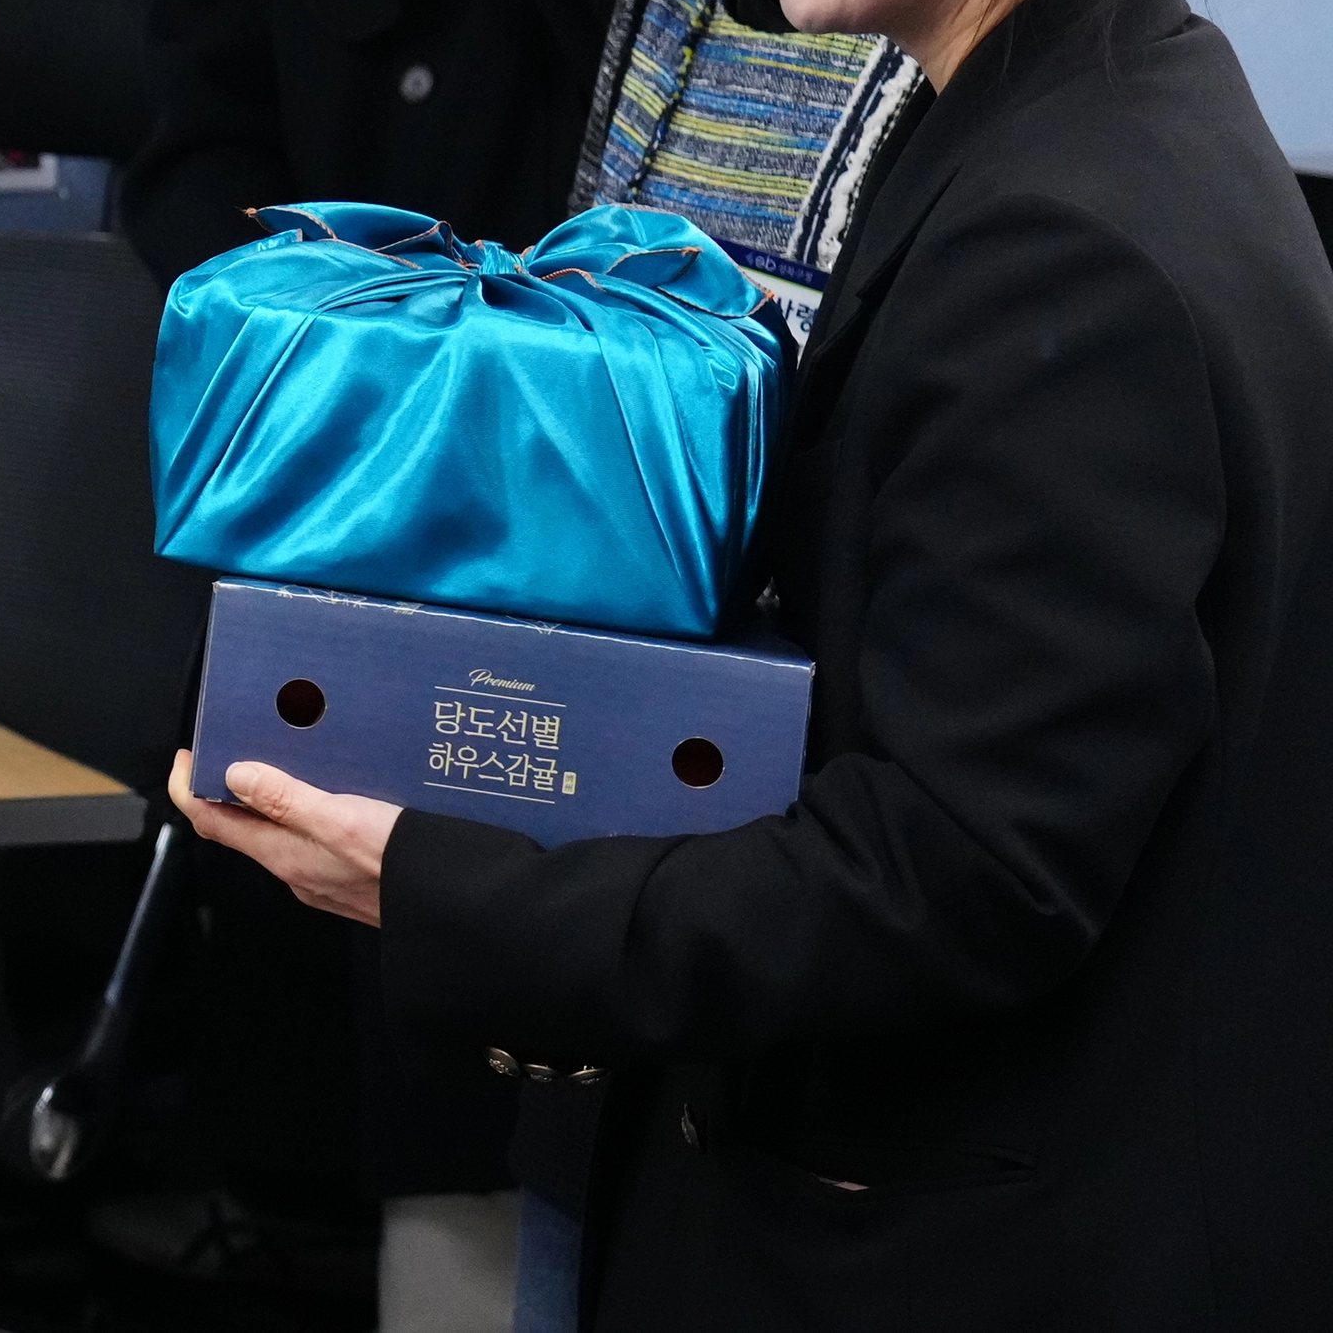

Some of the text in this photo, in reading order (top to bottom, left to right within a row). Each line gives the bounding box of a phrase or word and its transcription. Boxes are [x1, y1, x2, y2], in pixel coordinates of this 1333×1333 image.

[469, 668, 537, 691] Premium
[434, 701, 561, 750] 당도선별
[428, 741, 559, 792] 하우스감귤
